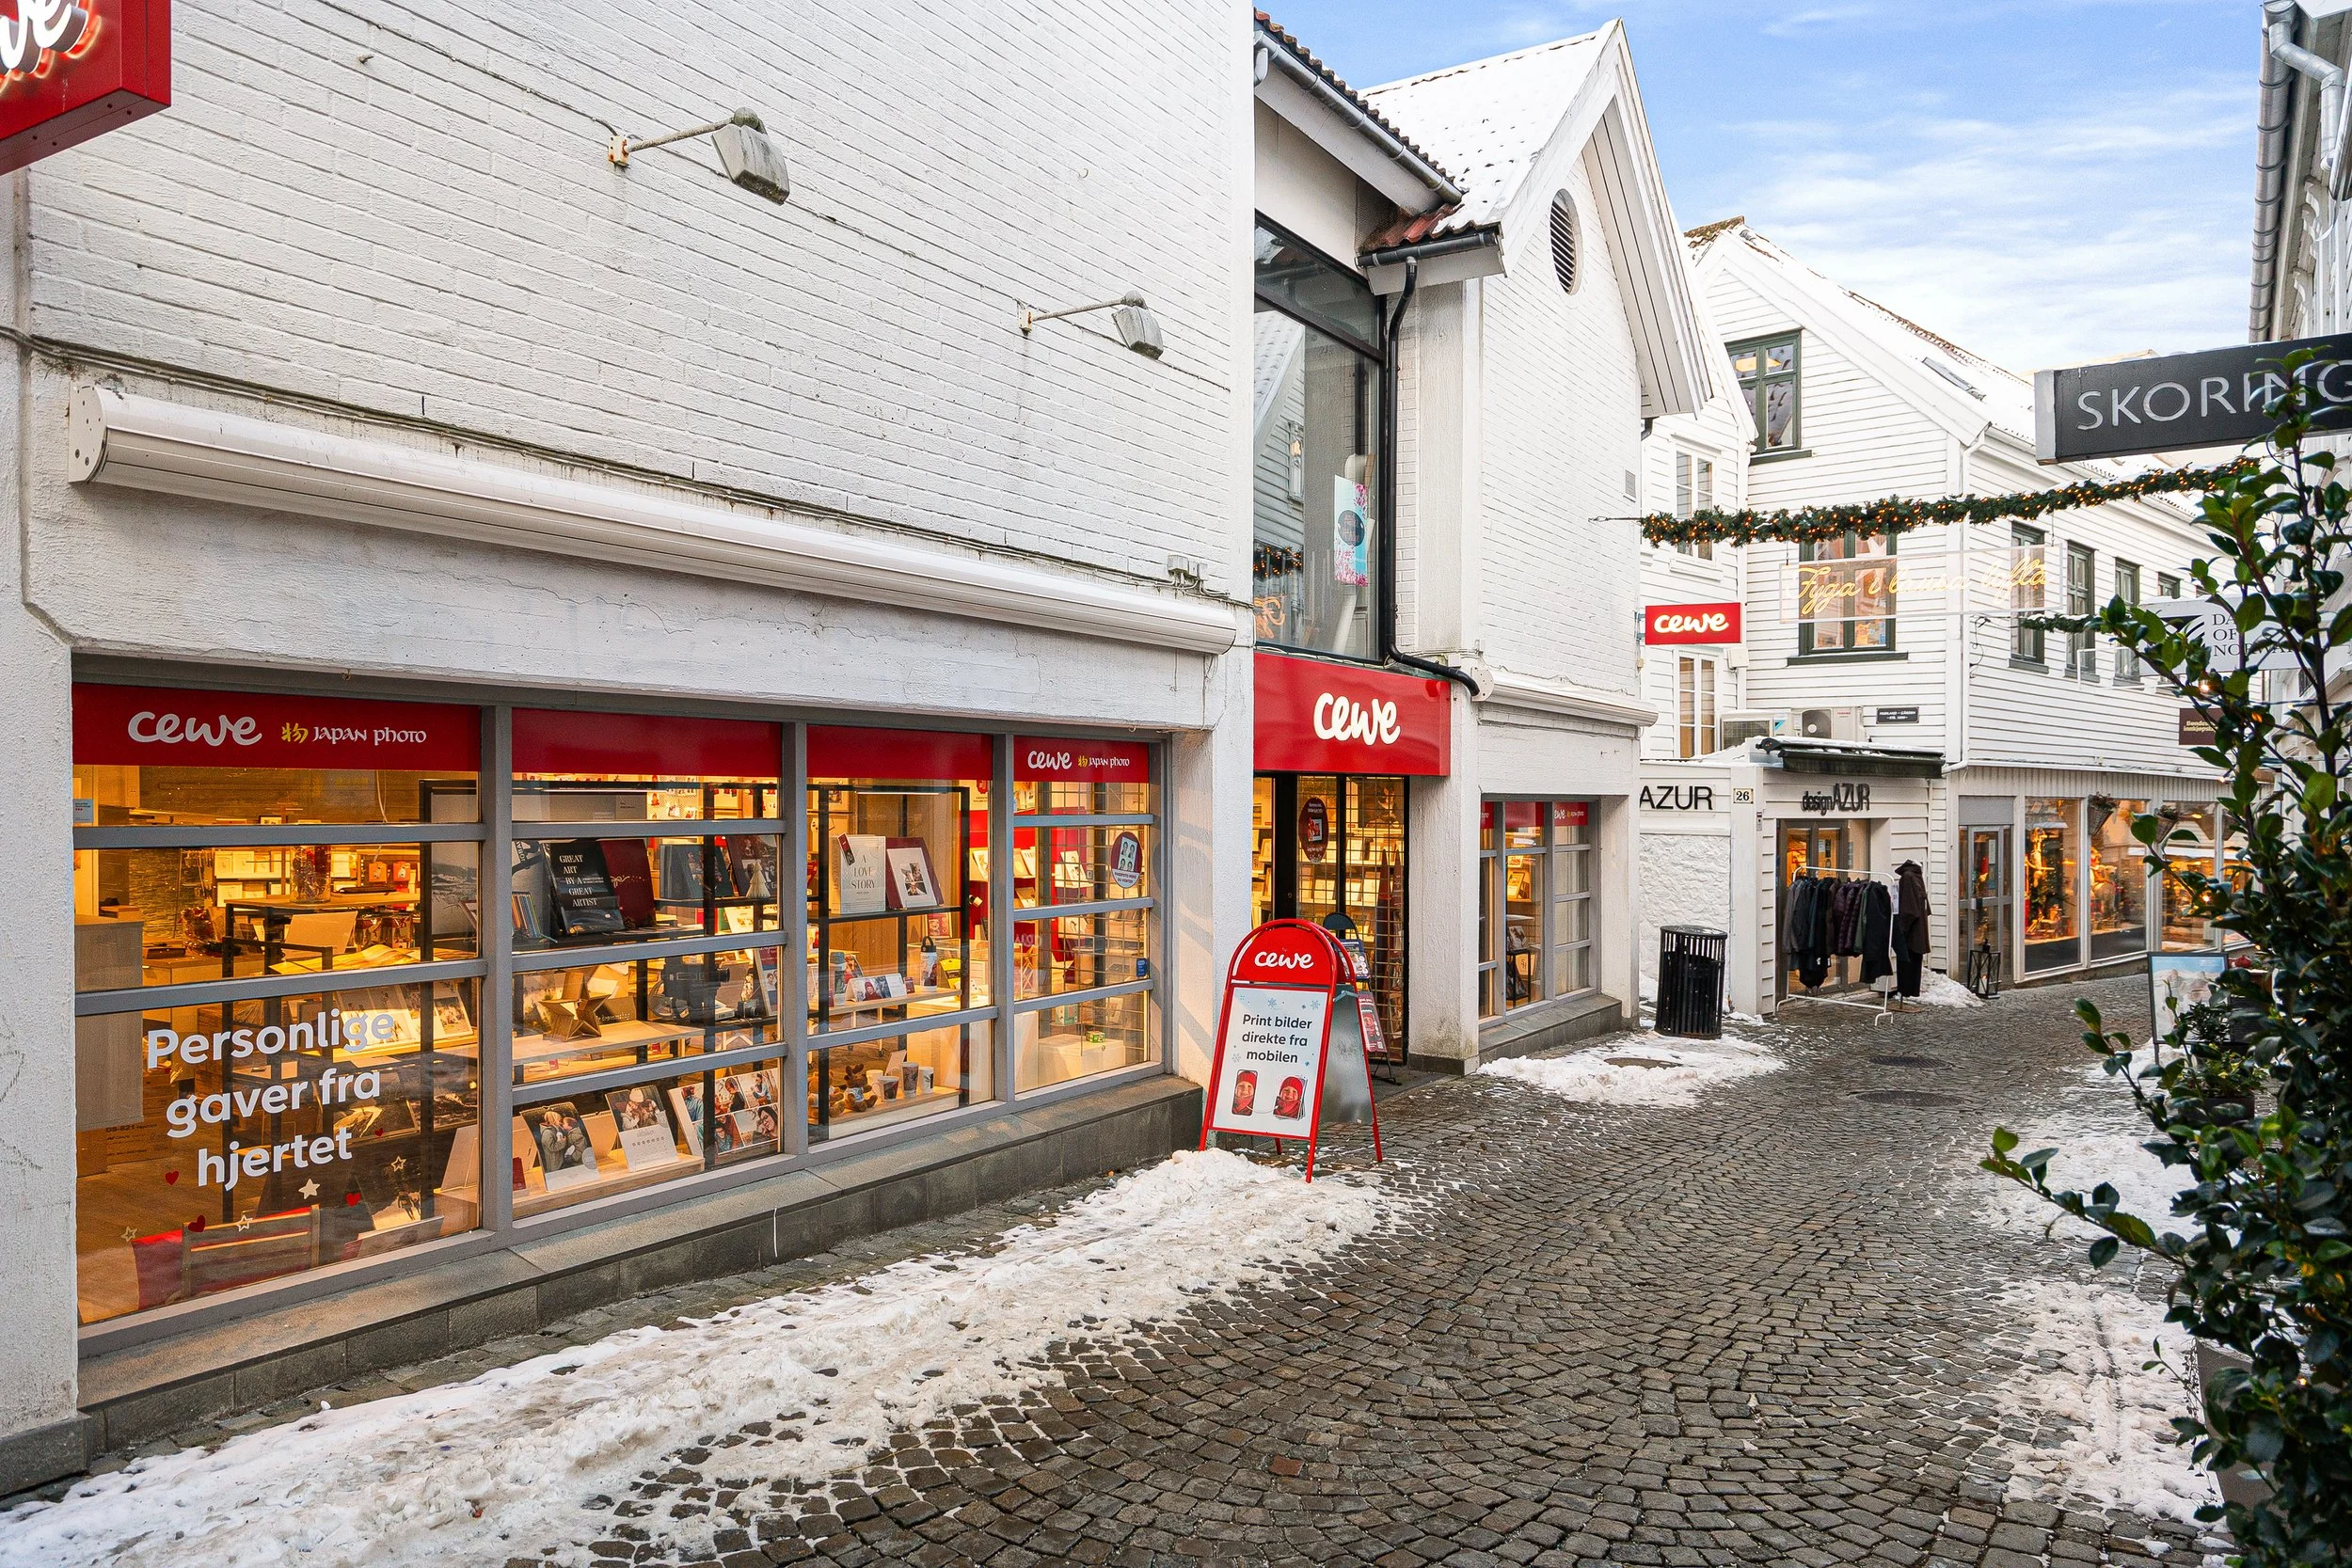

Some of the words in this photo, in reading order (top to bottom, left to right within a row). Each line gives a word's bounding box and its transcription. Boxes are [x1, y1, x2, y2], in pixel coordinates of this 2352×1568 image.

[1653, 612, 1729, 633] cewe
[1313, 692, 1401, 746] cewe
[128, 711, 262, 747] cewe
[1027, 751, 1073, 770] cewe
[1639, 785, 1713, 811] AZUR
[1736, 790, 1751, 801] 26
[559, 854, 583, 863] GREAT
[564, 865, 578, 874] ART
[853, 866, 873, 877] LOVE
[568, 887, 593, 895] GREAT
[850, 879, 875, 889] STORY
[572, 897, 597, 907] ARTIST
[1254, 951, 1314, 969] cewe
[1242, 1014, 1271, 1026] Print
[1274, 1016, 1312, 1029] bilder
[148, 1008, 394, 1069] Personlige
[1242, 1032, 1286, 1045] direkte
[1289, 1034, 1308, 1046] fra
[1246, 1051, 1298, 1063] mobilen
[166, 1081, 309, 1138] gaver
[318, 1068, 380, 1105] fra
[198, 1127, 353, 1192] hjertet
